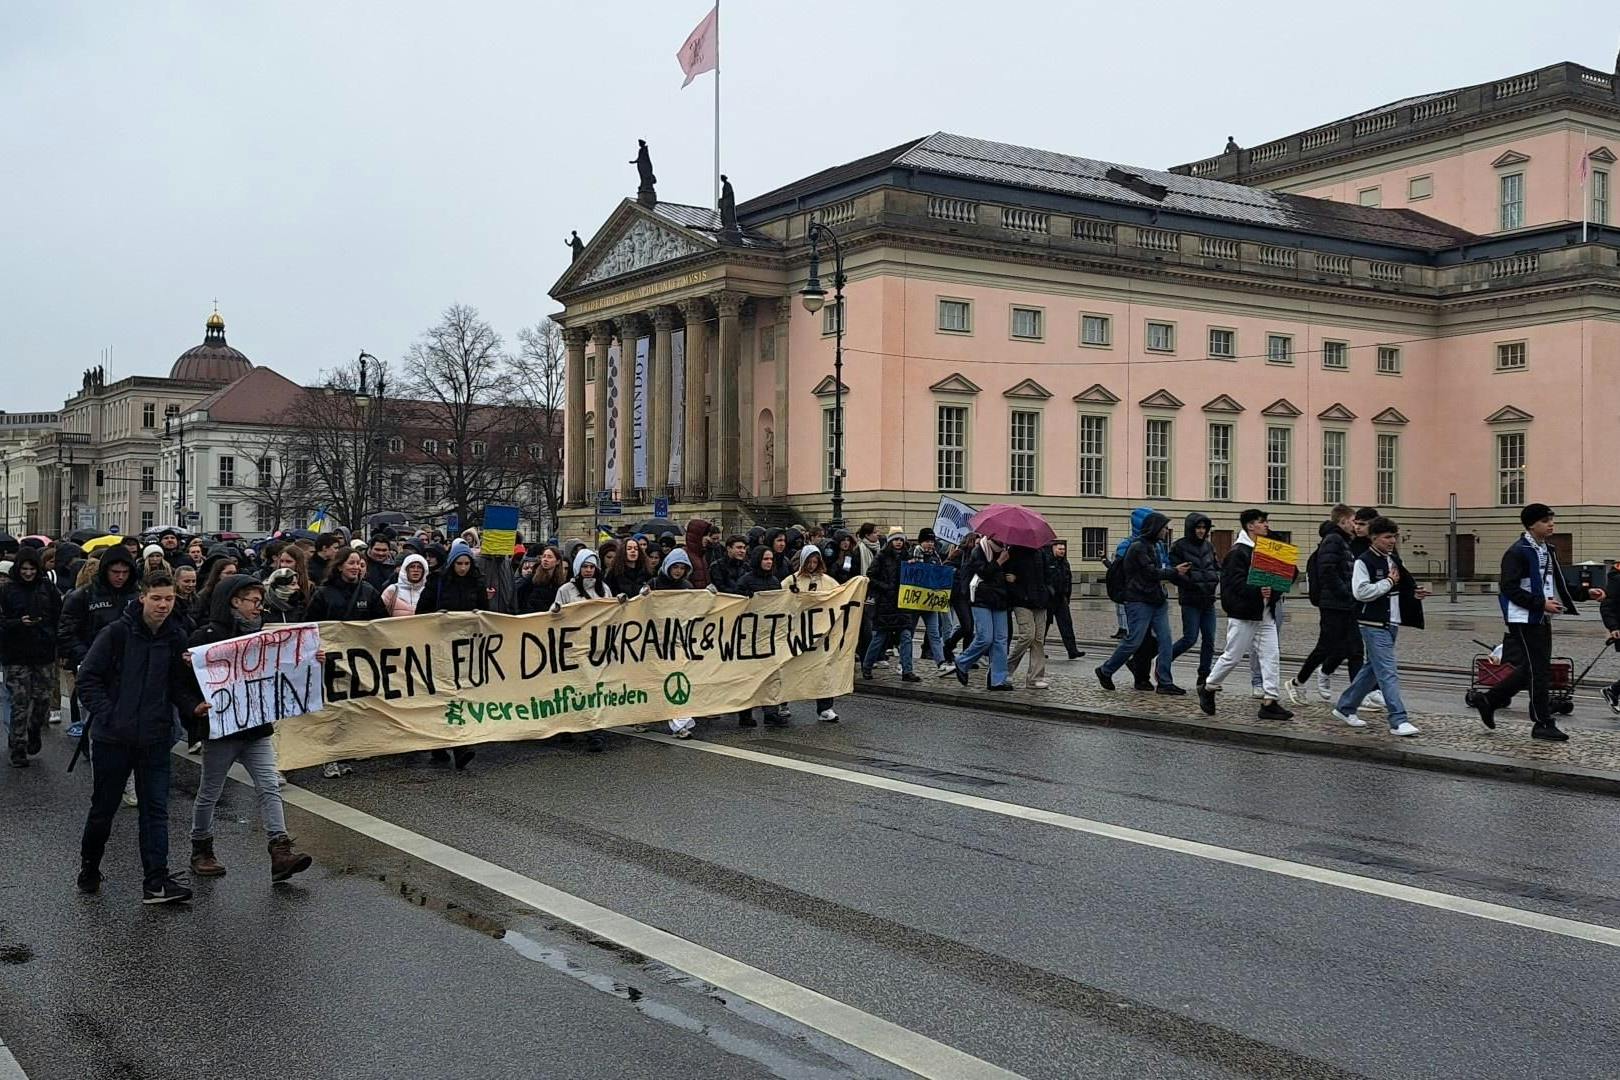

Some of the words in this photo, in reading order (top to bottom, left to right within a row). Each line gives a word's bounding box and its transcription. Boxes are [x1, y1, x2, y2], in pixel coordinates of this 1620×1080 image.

[633, 352, 645, 450] TURANDOT
[89, 601, 113, 610] KARL
[205, 626, 317, 685] STOPPT
[452, 633, 505, 690] FÜR
[521, 627, 581, 680] DIE
[211, 664, 312, 737] PUTIN
